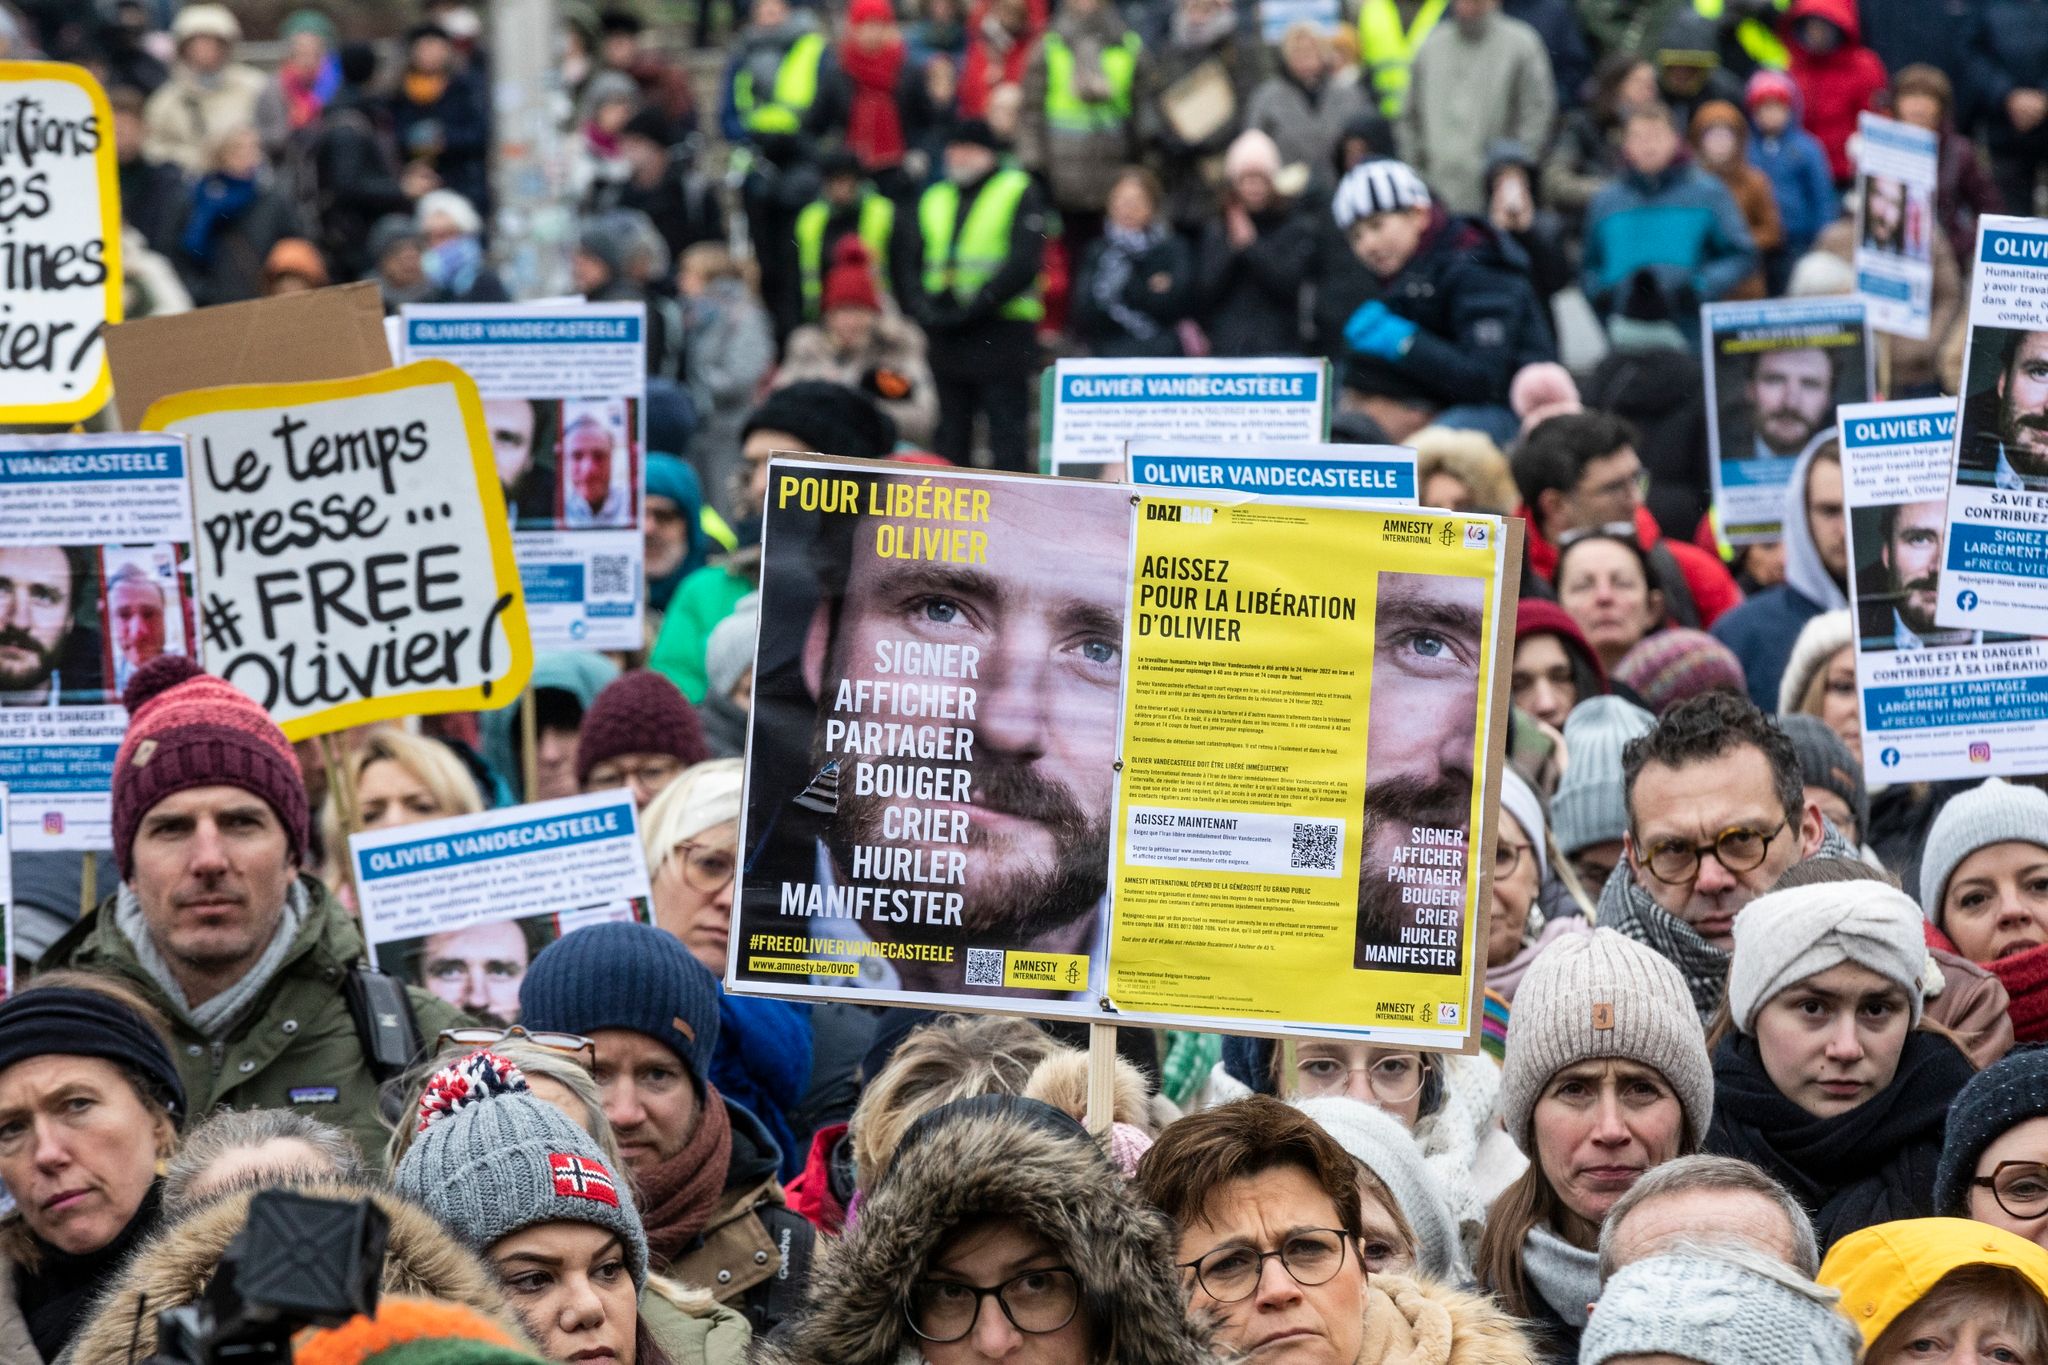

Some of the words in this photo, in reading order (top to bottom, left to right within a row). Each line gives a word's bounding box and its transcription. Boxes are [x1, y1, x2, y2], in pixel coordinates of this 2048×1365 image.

[1994, 237, 2048, 259] OLIVI
[1992, 283, 2016, 291] avoir
[1982, 295, 2006, 305] dans
[2014, 297, 2032, 307] des
[415, 322, 484, 340] OLIVIER
[487, 321, 627, 339] VANDECASTEELE
[1070, 377, 1144, 397] OLIVIER
[1147, 377, 1303, 396] VANDECASTEELE
[1855, 419, 1931, 441] OLIVIER
[7, 453, 168, 474] VANDECASTEELE
[272, 413, 428, 494] temps
[1144, 463, 1224, 485] OLIVIER
[1228, 466, 1398, 489] VANDECASTEELE
[778, 476, 859, 514] POUR
[868, 478, 991, 523] LIBÉRER
[1991, 493, 2007, 505] SA
[2012, 495, 2032, 507] VIE
[1965, 507, 2048, 523] CONTRIBUEZ
[1383, 519, 1434, 535] AMNESTY
[1995, 530, 2041, 544] SIGNEZ
[875, 524, 988, 565] OLIVIER
[1383, 534, 1432, 545] INTERNATIONAL
[1964, 542, 2041, 559] LARGEMENT
[1141, 555, 1229, 583] AGISSEZ
[1140, 584, 1198, 610] POUR
[1205, 588, 1228, 612] LA
[1235, 587, 1357, 621] LIBÉRATION
[1139, 613, 1241, 642] D'OLIVIER
[875, 640, 979, 678] SIGNER
[1896, 655, 1910, 664] SA
[1914, 654, 1932, 663] VIE
[1937, 651, 1957, 661] EST
[1962, 650, 1978, 660] EN
[1982, 646, 2032, 659] DANGER
[1228, 662, 1261, 670] Vandecasteele
[1873, 666, 1949, 680] CONTRIBUEZ
[1955, 664, 1962, 675] À
[1966, 664, 1981, 674] SA
[1985, 660, 2048, 673] LIBÉRATIO
[1904, 683, 1947, 698] SIGNEZ
[1951, 684, 1964, 695] ET
[1968, 679, 2027, 695] PARTAGEZ
[835, 679, 976, 719] AFFICHER
[1878, 698, 1949, 714] LARGEMENT
[1952, 695, 1991, 708] NOTRE
[1995, 692, 2048, 705] PÉTITION
[827, 720, 973, 761] PARTAGER
[1131, 756, 1152, 764] OLIVIER
[1154, 758, 1196, 767] VANDECASTEELE
[1211, 761, 1224, 769] ÊTRE
[1225, 762, 1244, 770] LIBÉRÉ
[1246, 764, 1289, 772] IMMÉDIATEMENT
[856, 762, 971, 802] BOUGER
[884, 806, 969, 843] CRIER
[1135, 813, 1175, 826] AGISSEZ
[1178, 816, 1238, 830] MAINTENANT
[370, 842, 449, 871] OLIVIER
[451, 812, 617, 857] VANDECASTEELE
[1411, 826, 1464, 846] SIGNER
[853, 846, 967, 884] HURLER
[1392, 846, 1462, 866] AFFICHER
[1388, 866, 1461, 886] PARTAGER
[1150, 879, 1189, 887] INTERNATIONAL
[1191, 880, 1212, 889] DÉPEND
[1229, 882, 1262, 892] GÉNÉROSITÉ
[1272, 886, 1290, 894] GRAND
[1291, 887, 1311, 895] PUBLIC
[1402, 887, 1460, 906] BOUGER
[781, 882, 963, 926] MANIFESTER
[1416, 908, 1458, 926] CRIER
[1401, 927, 1457, 946] HURLER
[750, 934, 954, 962] #FREEOLIVIERVANDECASTEELE
[1365, 945, 1456, 966] MANIFESTER
[752, 959, 855, 977] www.amnesty.be/OVDC
[1013, 959, 1057, 973] AMNESTY
[1012, 972, 1057, 983] INTERNATIONAL
[1376, 1002, 1415, 1013] AMNESTY
[1376, 1013, 1414, 1022] INTERNATIONAL
